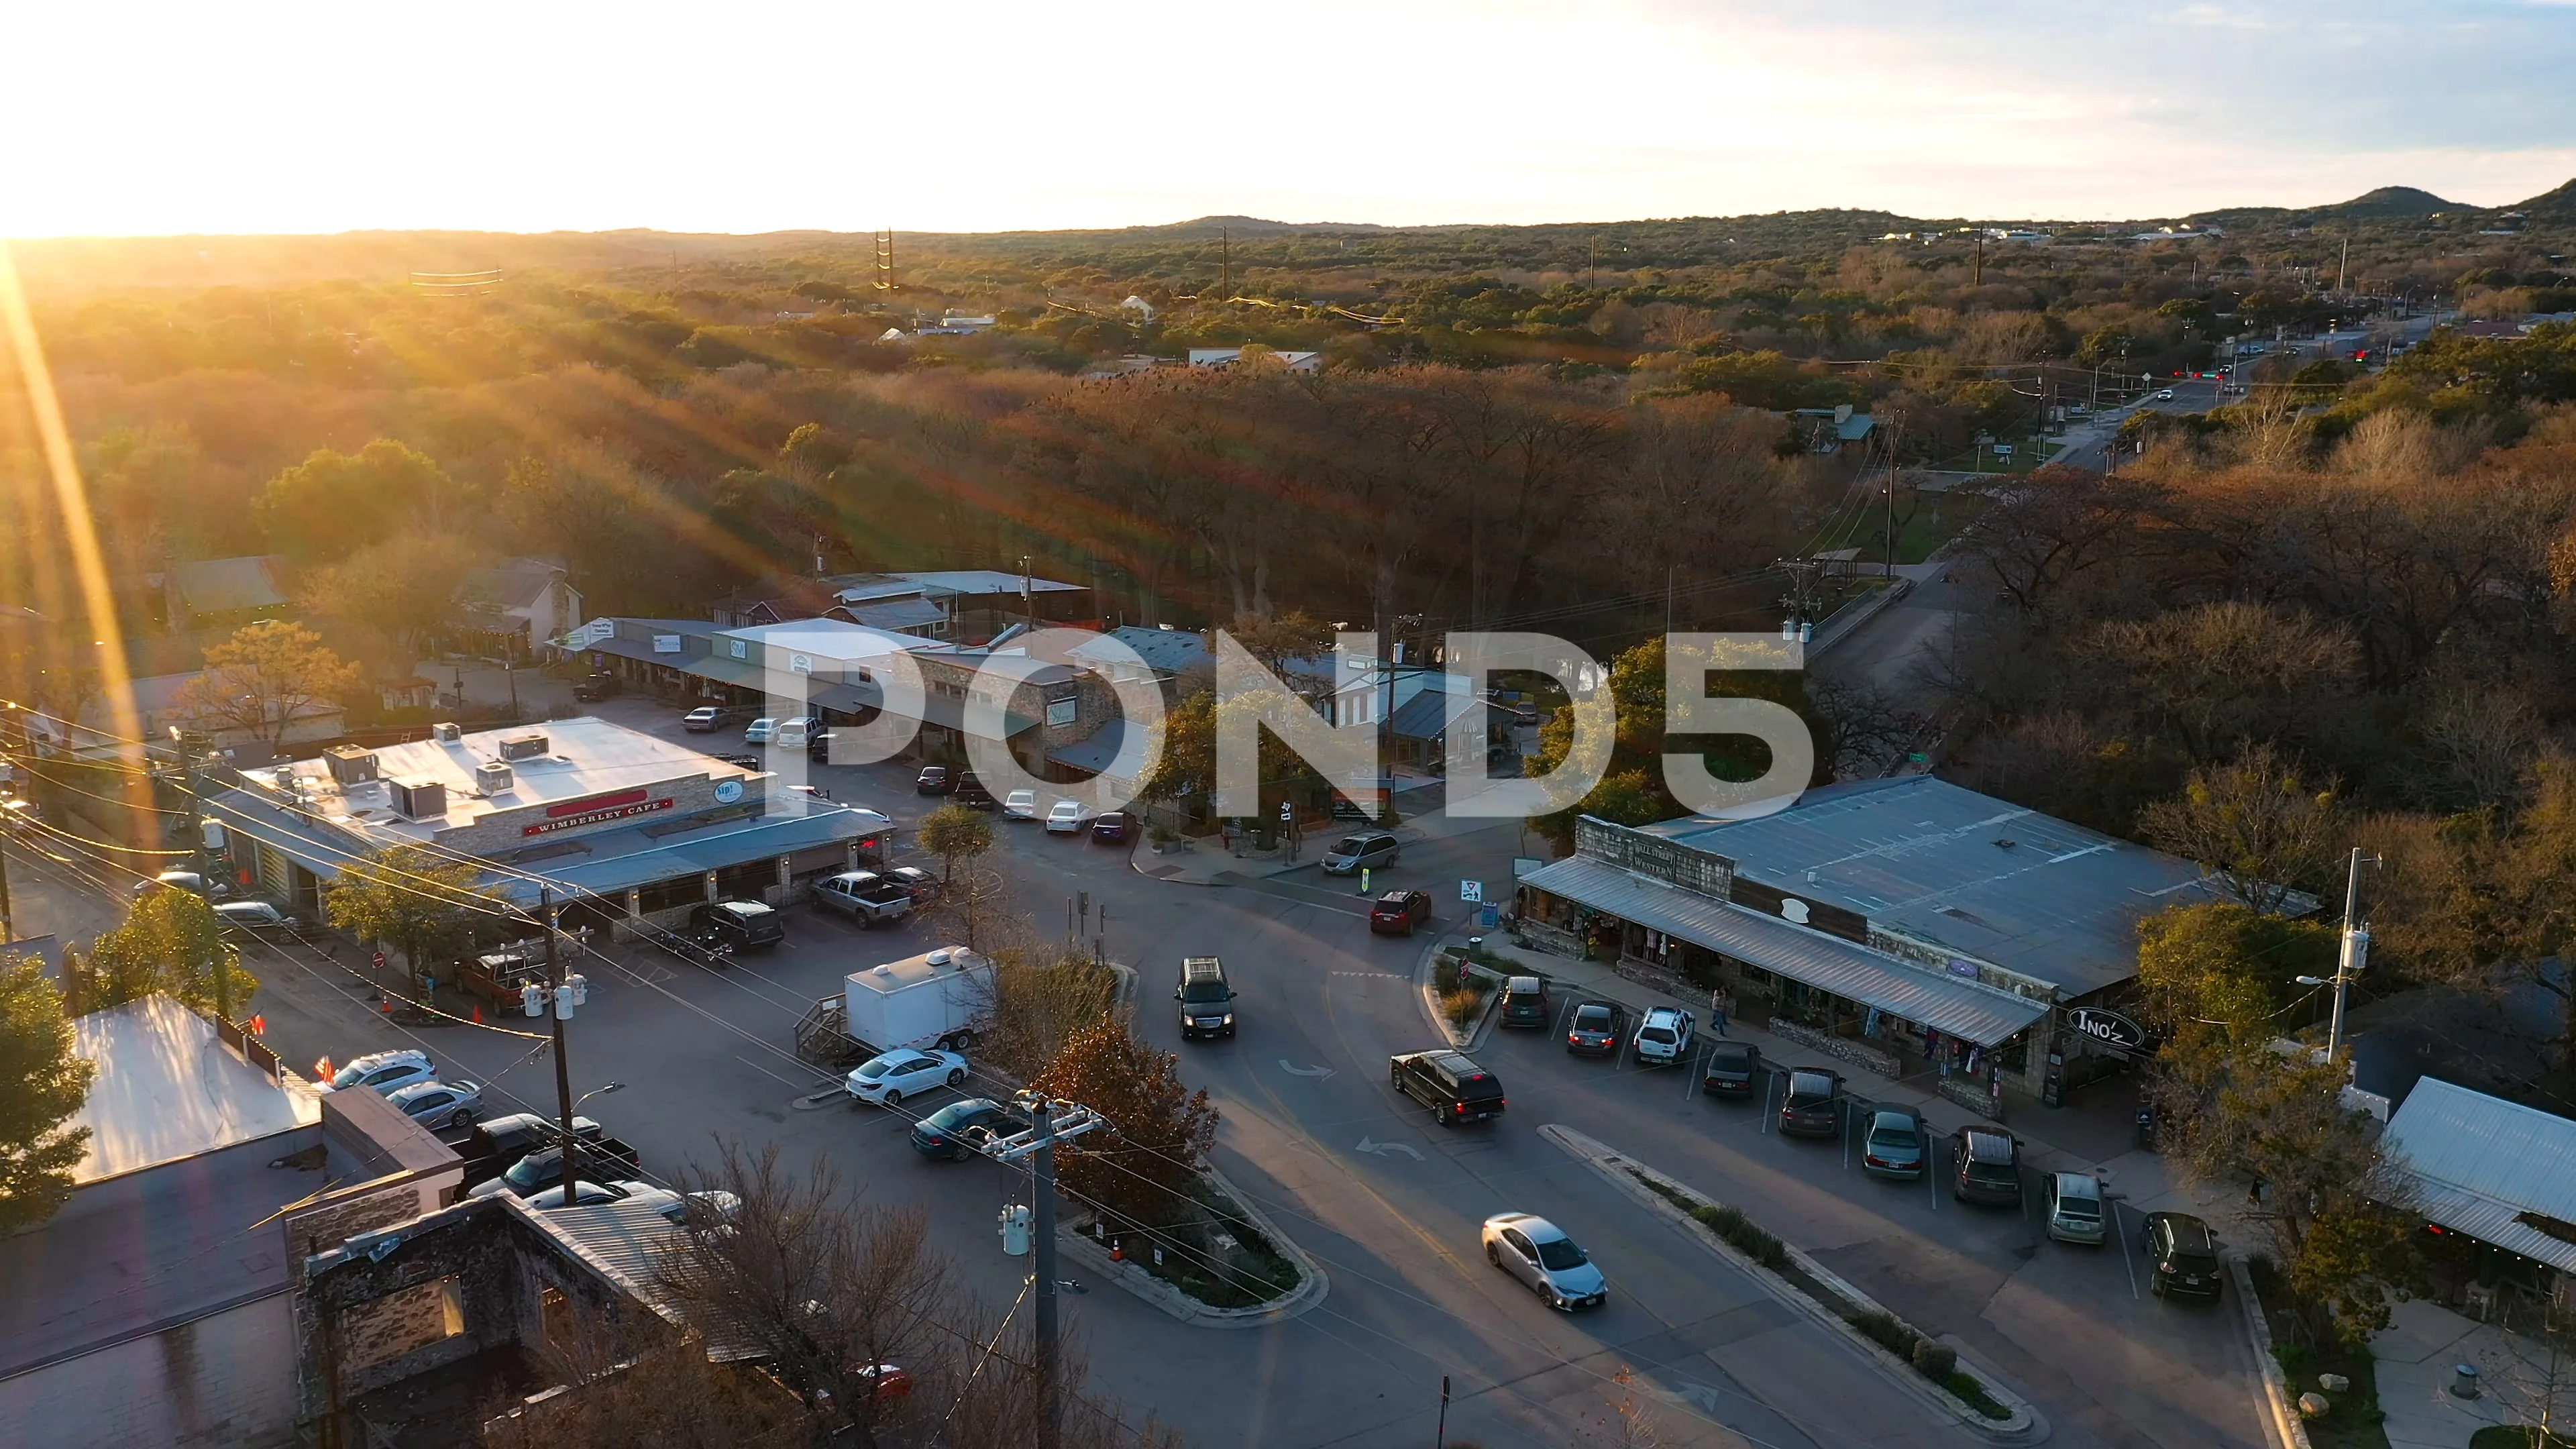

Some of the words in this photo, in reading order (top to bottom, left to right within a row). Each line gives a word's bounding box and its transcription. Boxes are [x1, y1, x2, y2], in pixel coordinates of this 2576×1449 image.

[539, 810, 622, 833] WIMBERLEY
[627, 802, 661, 814] CAFE
[1634, 856, 1672, 877] WESTERN
